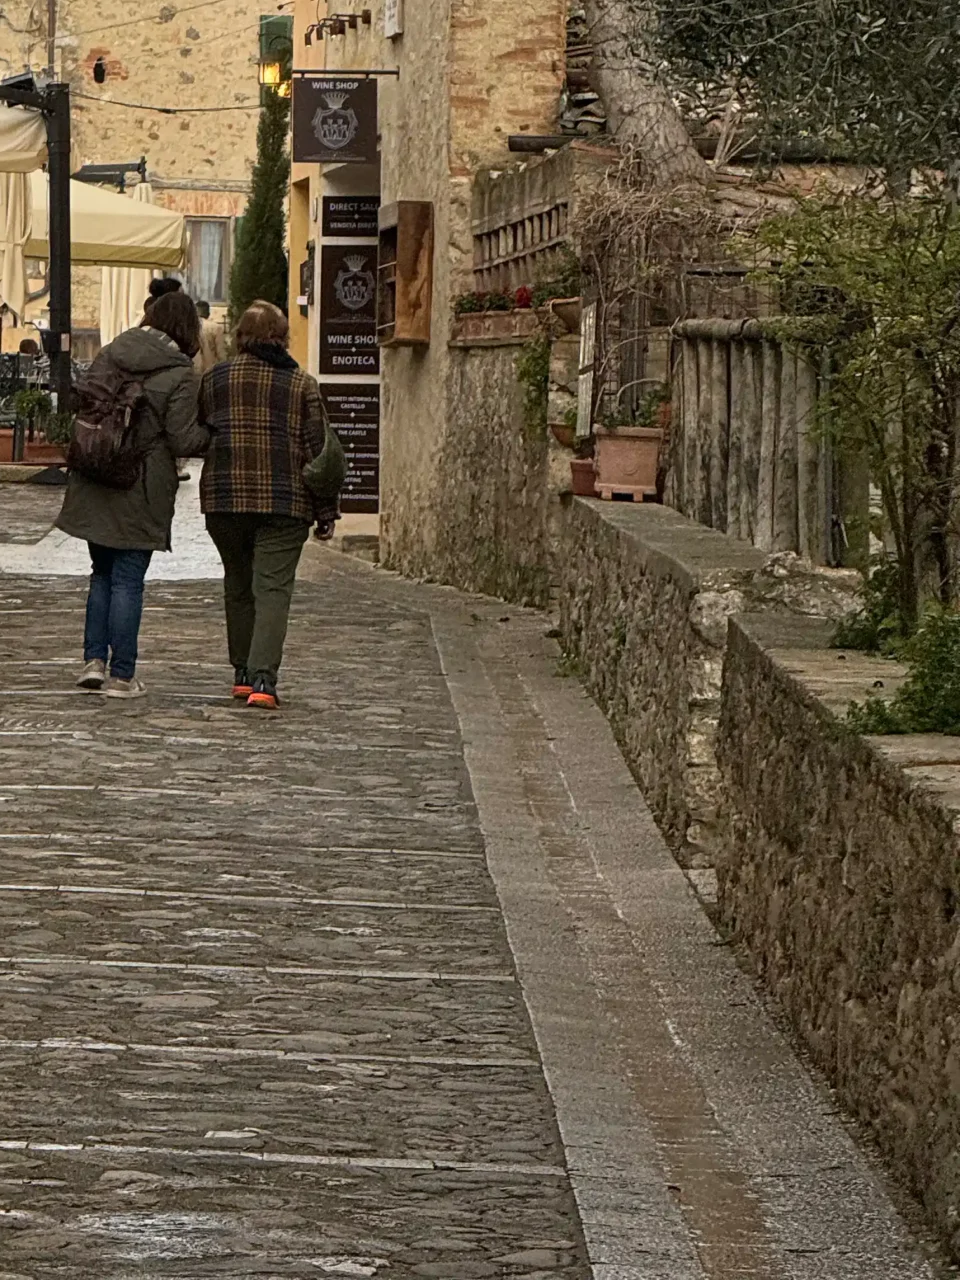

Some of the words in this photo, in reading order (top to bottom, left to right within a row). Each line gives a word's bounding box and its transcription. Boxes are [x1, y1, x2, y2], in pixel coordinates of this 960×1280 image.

[312, 81, 335, 90] WINE
[335, 81, 359, 90] SHOP
[329, 202, 358, 211] DIRECT
[327, 334, 353, 344] WINE
[332, 355, 376, 365] ENOTECA
